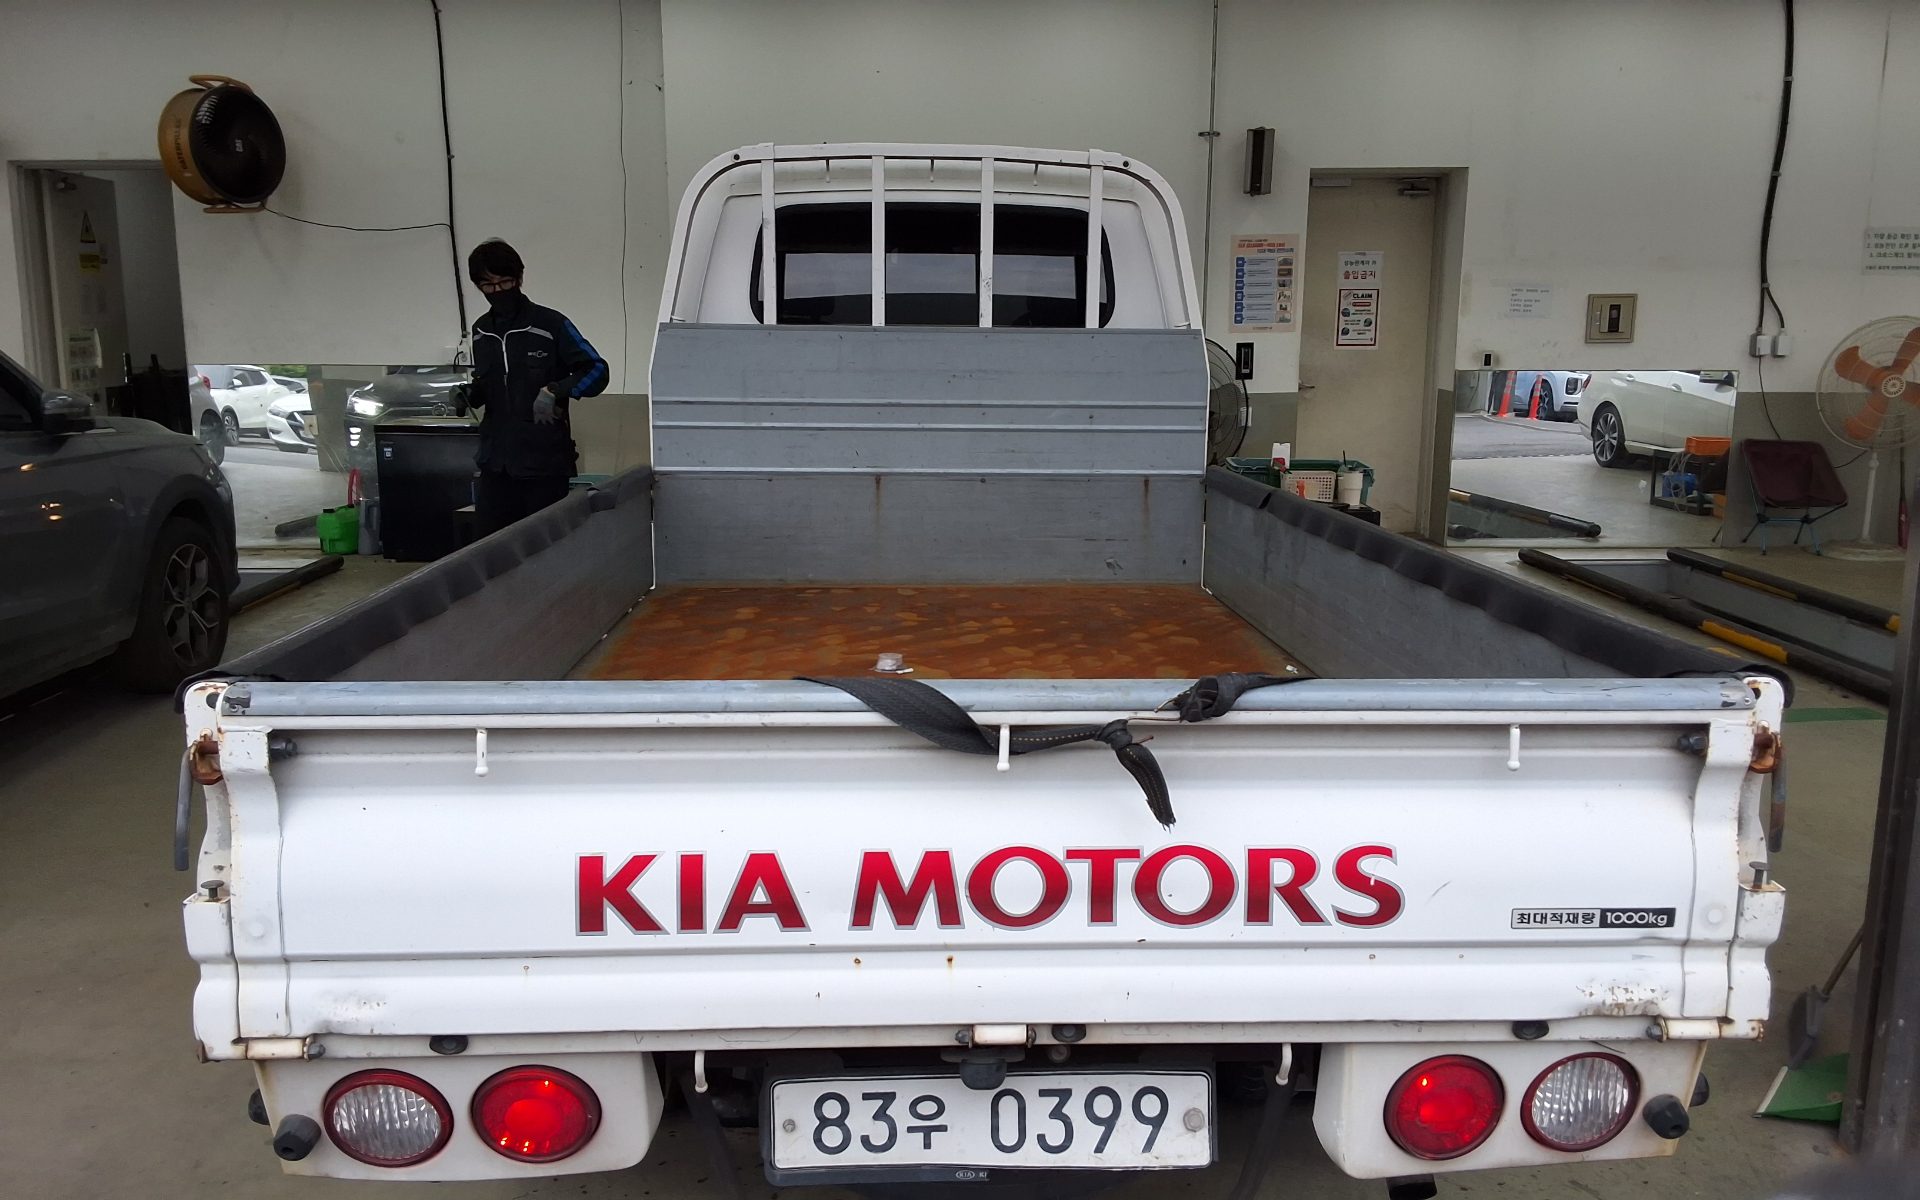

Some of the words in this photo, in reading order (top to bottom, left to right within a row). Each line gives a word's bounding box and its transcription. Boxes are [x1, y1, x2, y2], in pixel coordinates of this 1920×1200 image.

[1343, 270, 1376, 280] 출입금지
[575, 850, 812, 936] KIA
[848, 844, 1406, 931] MOTORS
[1516, 912, 1596, 925] 최대적재량
[1605, 911, 1668, 926] 1000kg
[813, 1091, 948, 1155] 83우
[990, 1085, 1169, 1154] 0399
